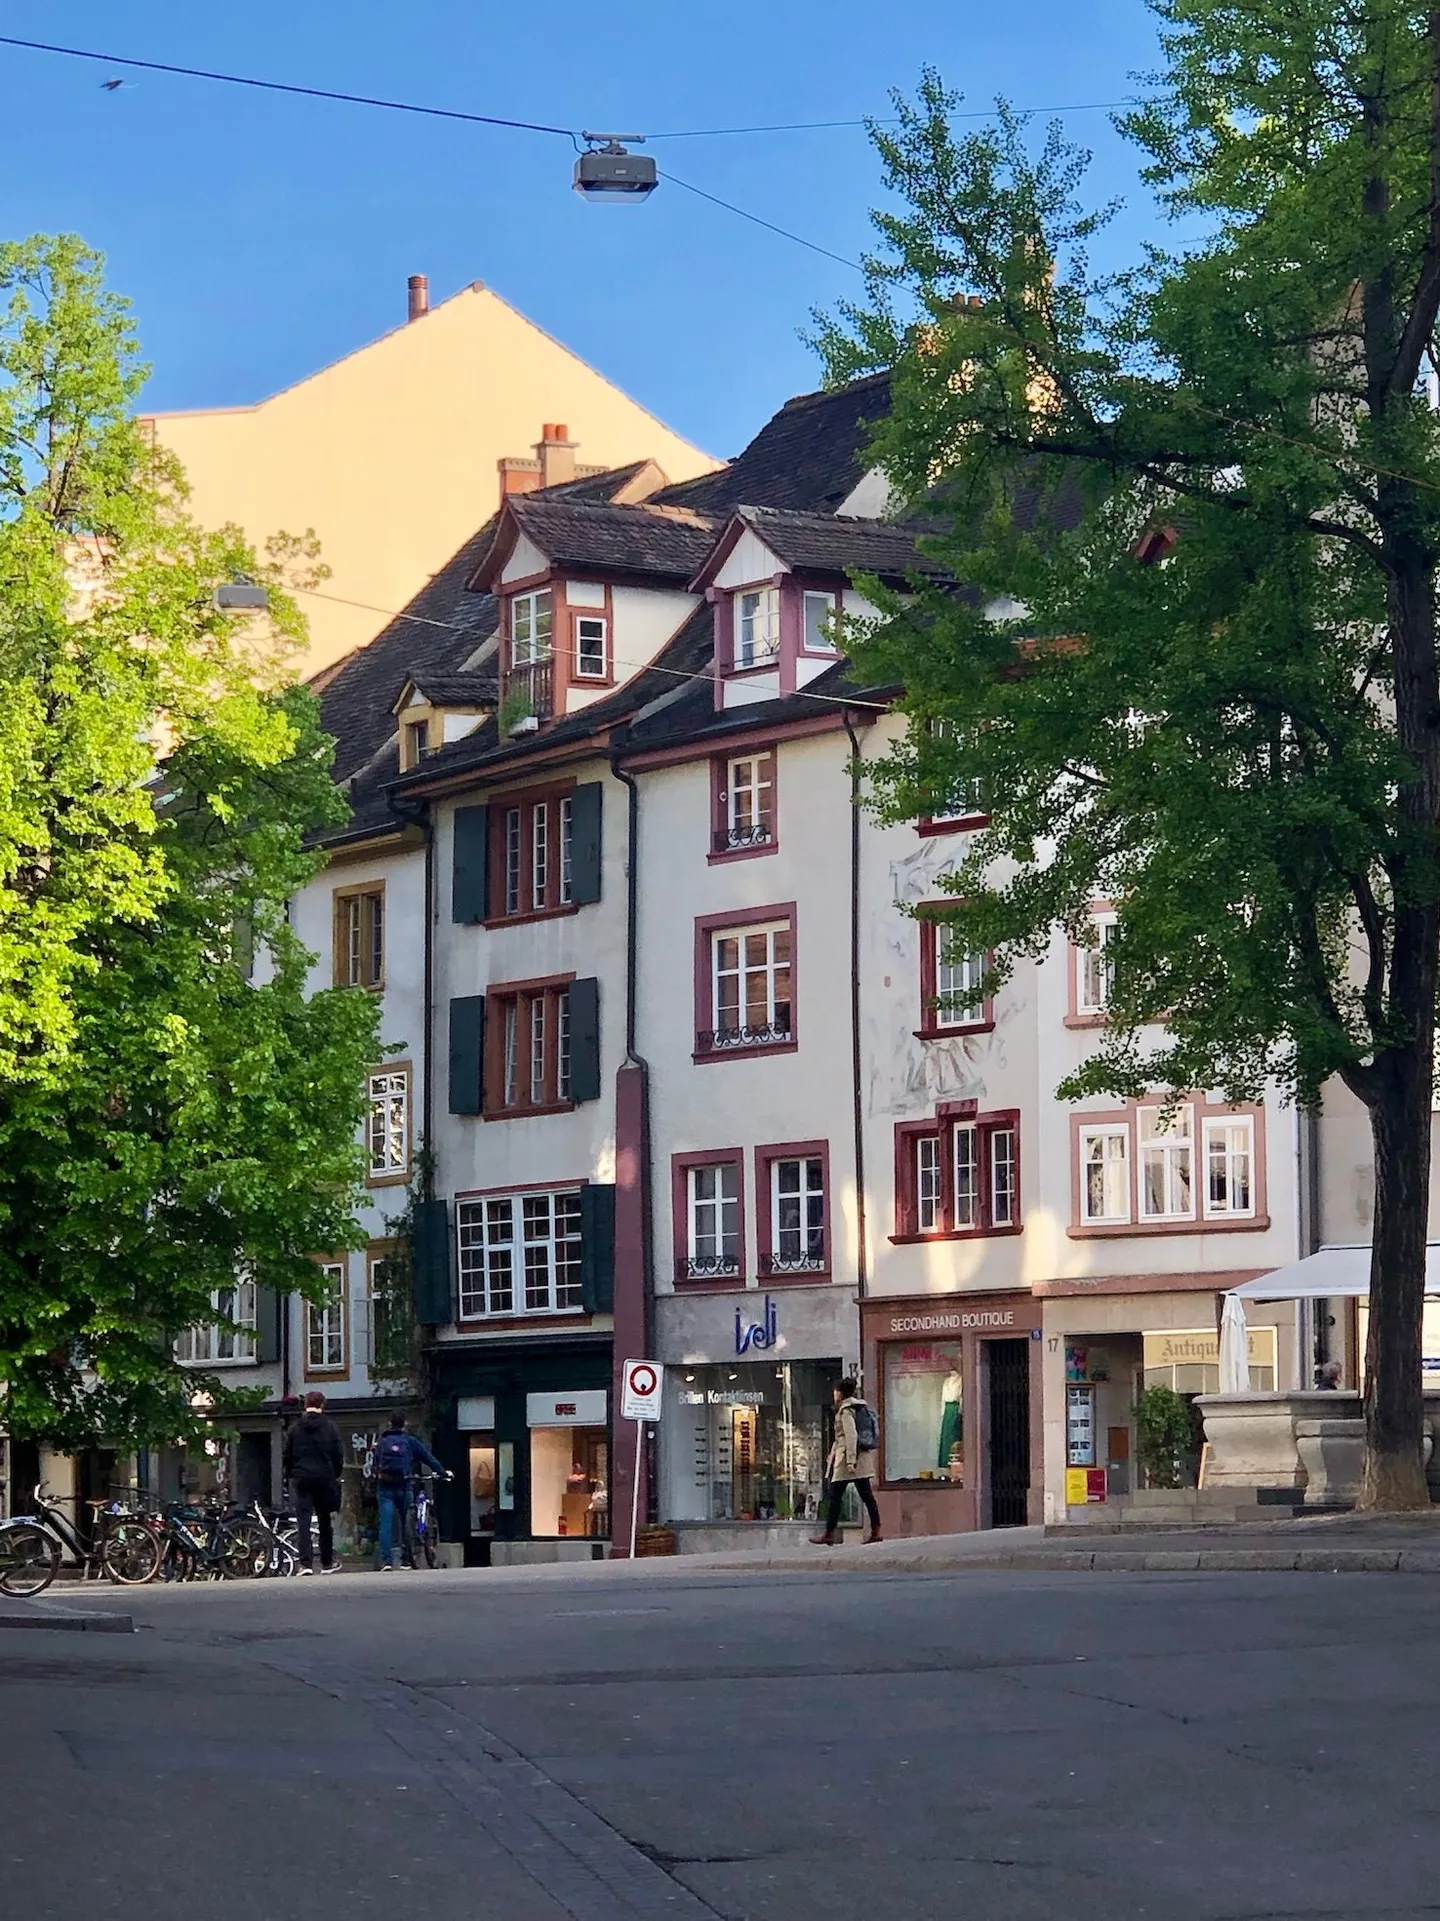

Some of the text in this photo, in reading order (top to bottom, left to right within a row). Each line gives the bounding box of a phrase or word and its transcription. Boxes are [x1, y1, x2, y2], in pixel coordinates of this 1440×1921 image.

[891, 1311, 1014, 1332] SECONDHAND BOUTIQUE
[1048, 1338, 1058, 1352] 17
[679, 1389, 764, 1404] Brillen Kontaktlinsen
